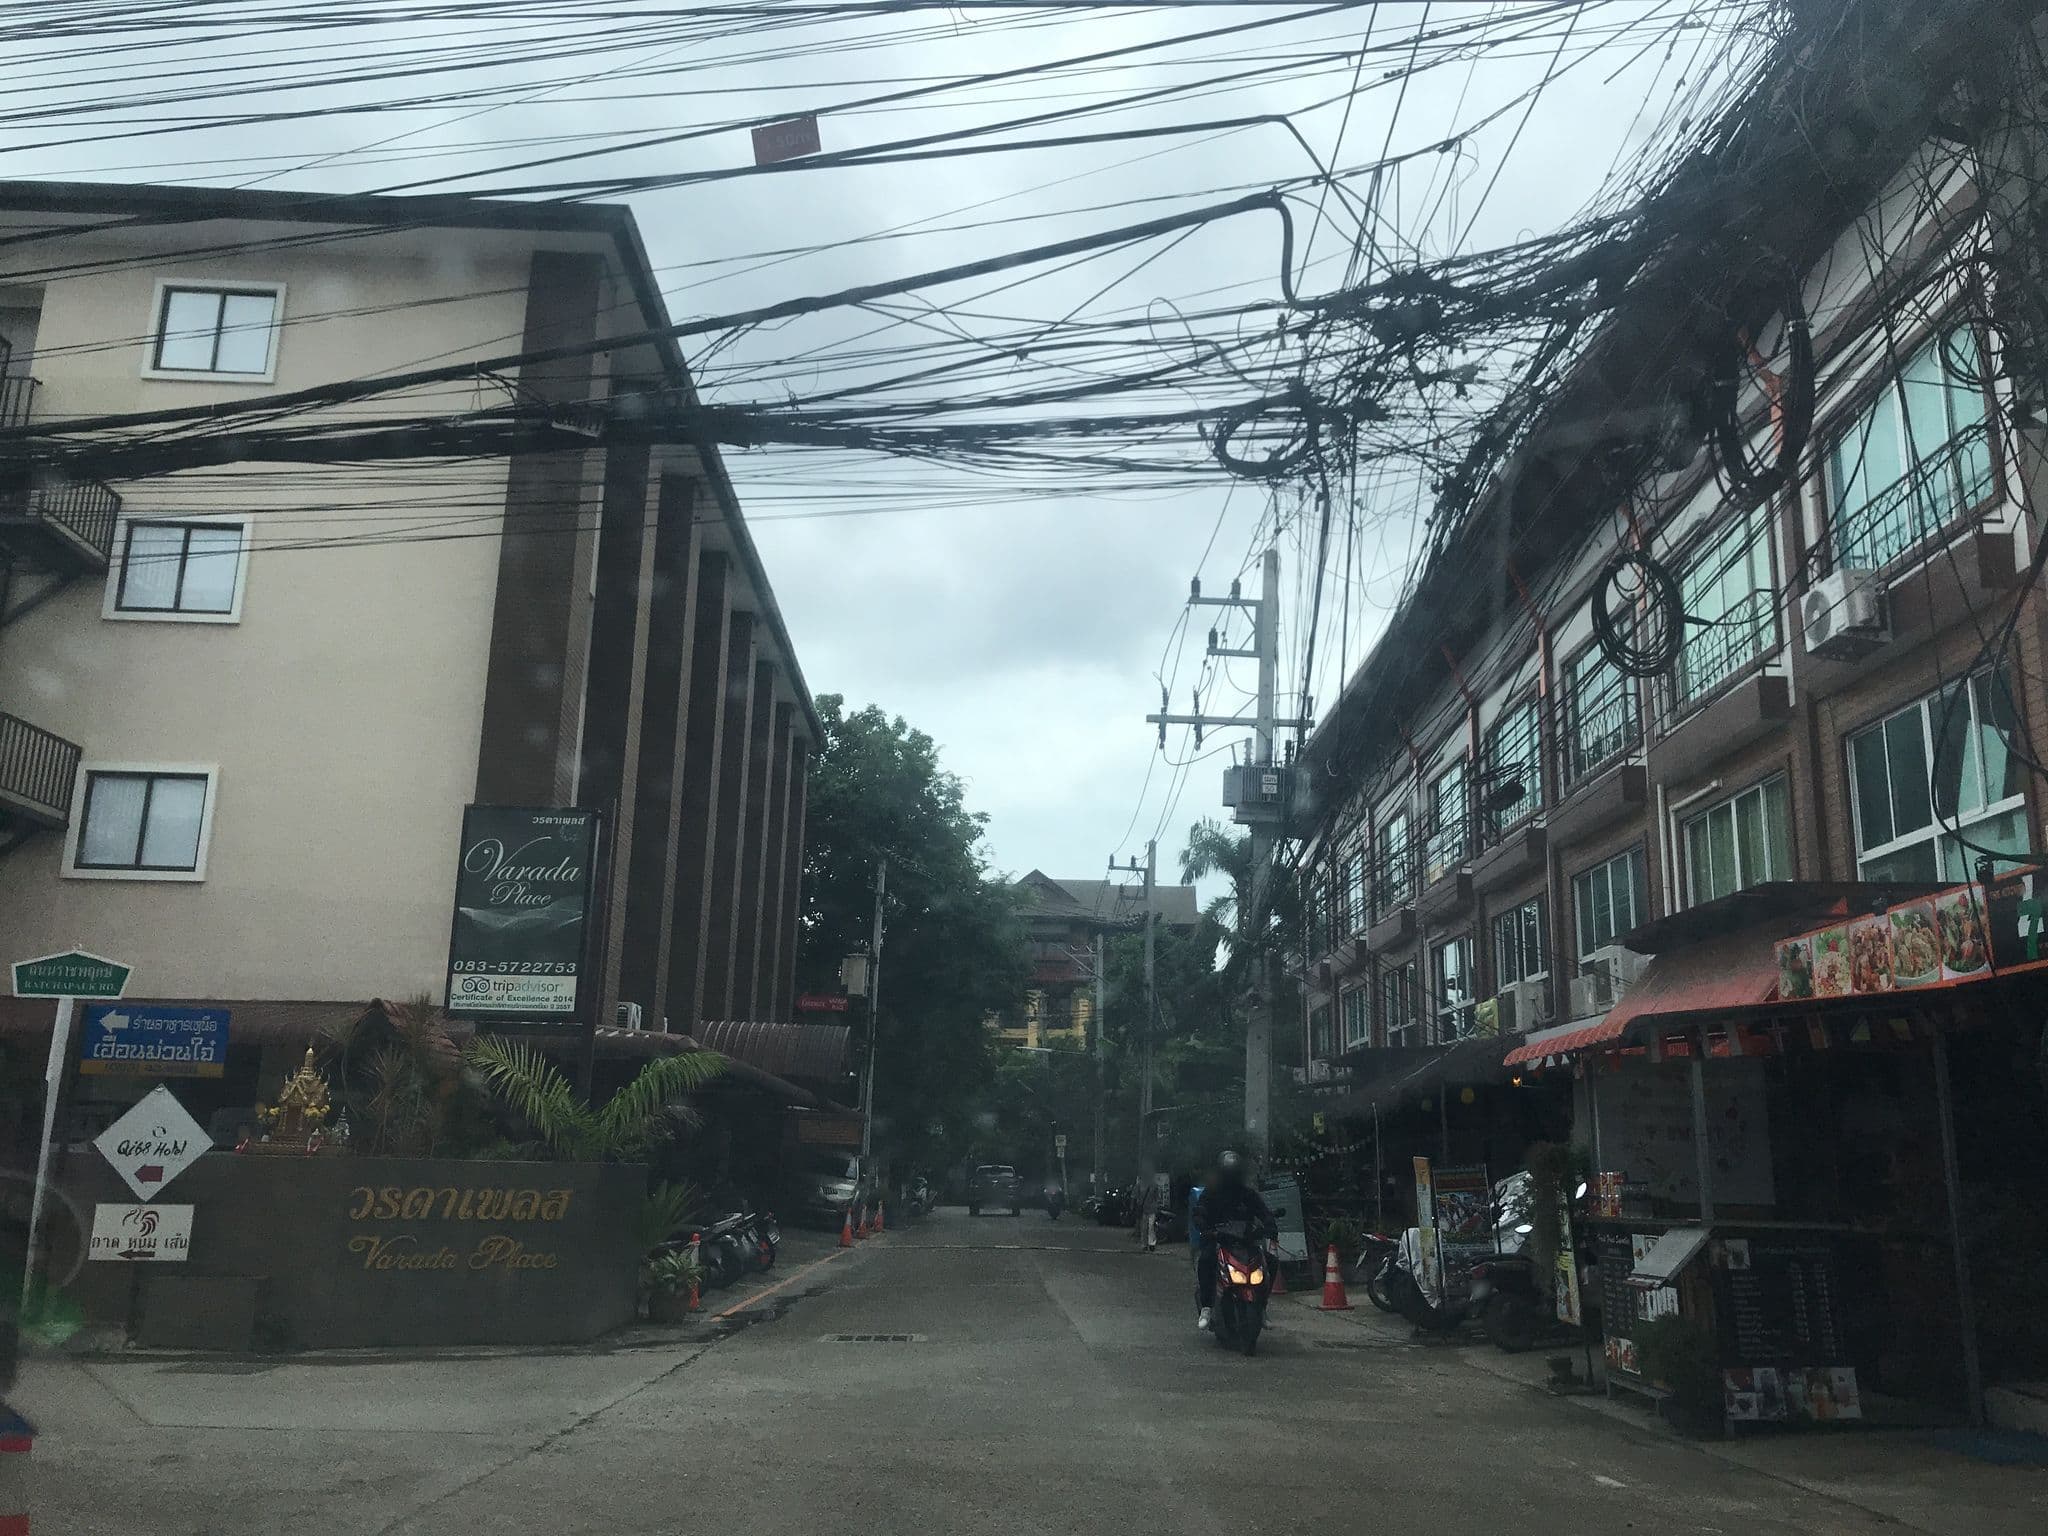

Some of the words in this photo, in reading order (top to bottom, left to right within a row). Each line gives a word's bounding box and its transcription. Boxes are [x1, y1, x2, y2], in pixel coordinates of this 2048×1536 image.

[464, 835, 582, 882] Varada
[489, 880, 553, 904] Place
[453, 960, 577, 974] 083-5722753
[450, 993, 493, 1001] Certificate
[507, 994, 551, 1003] Excellence
[553, 995, 573, 1003] 2014
[493, 980, 561, 994] tripadvisor
[350, 1186, 574, 1221] วรดาเพลส
[348, 1233, 458, 1271] Varada
[467, 1234, 560, 1271] Place
